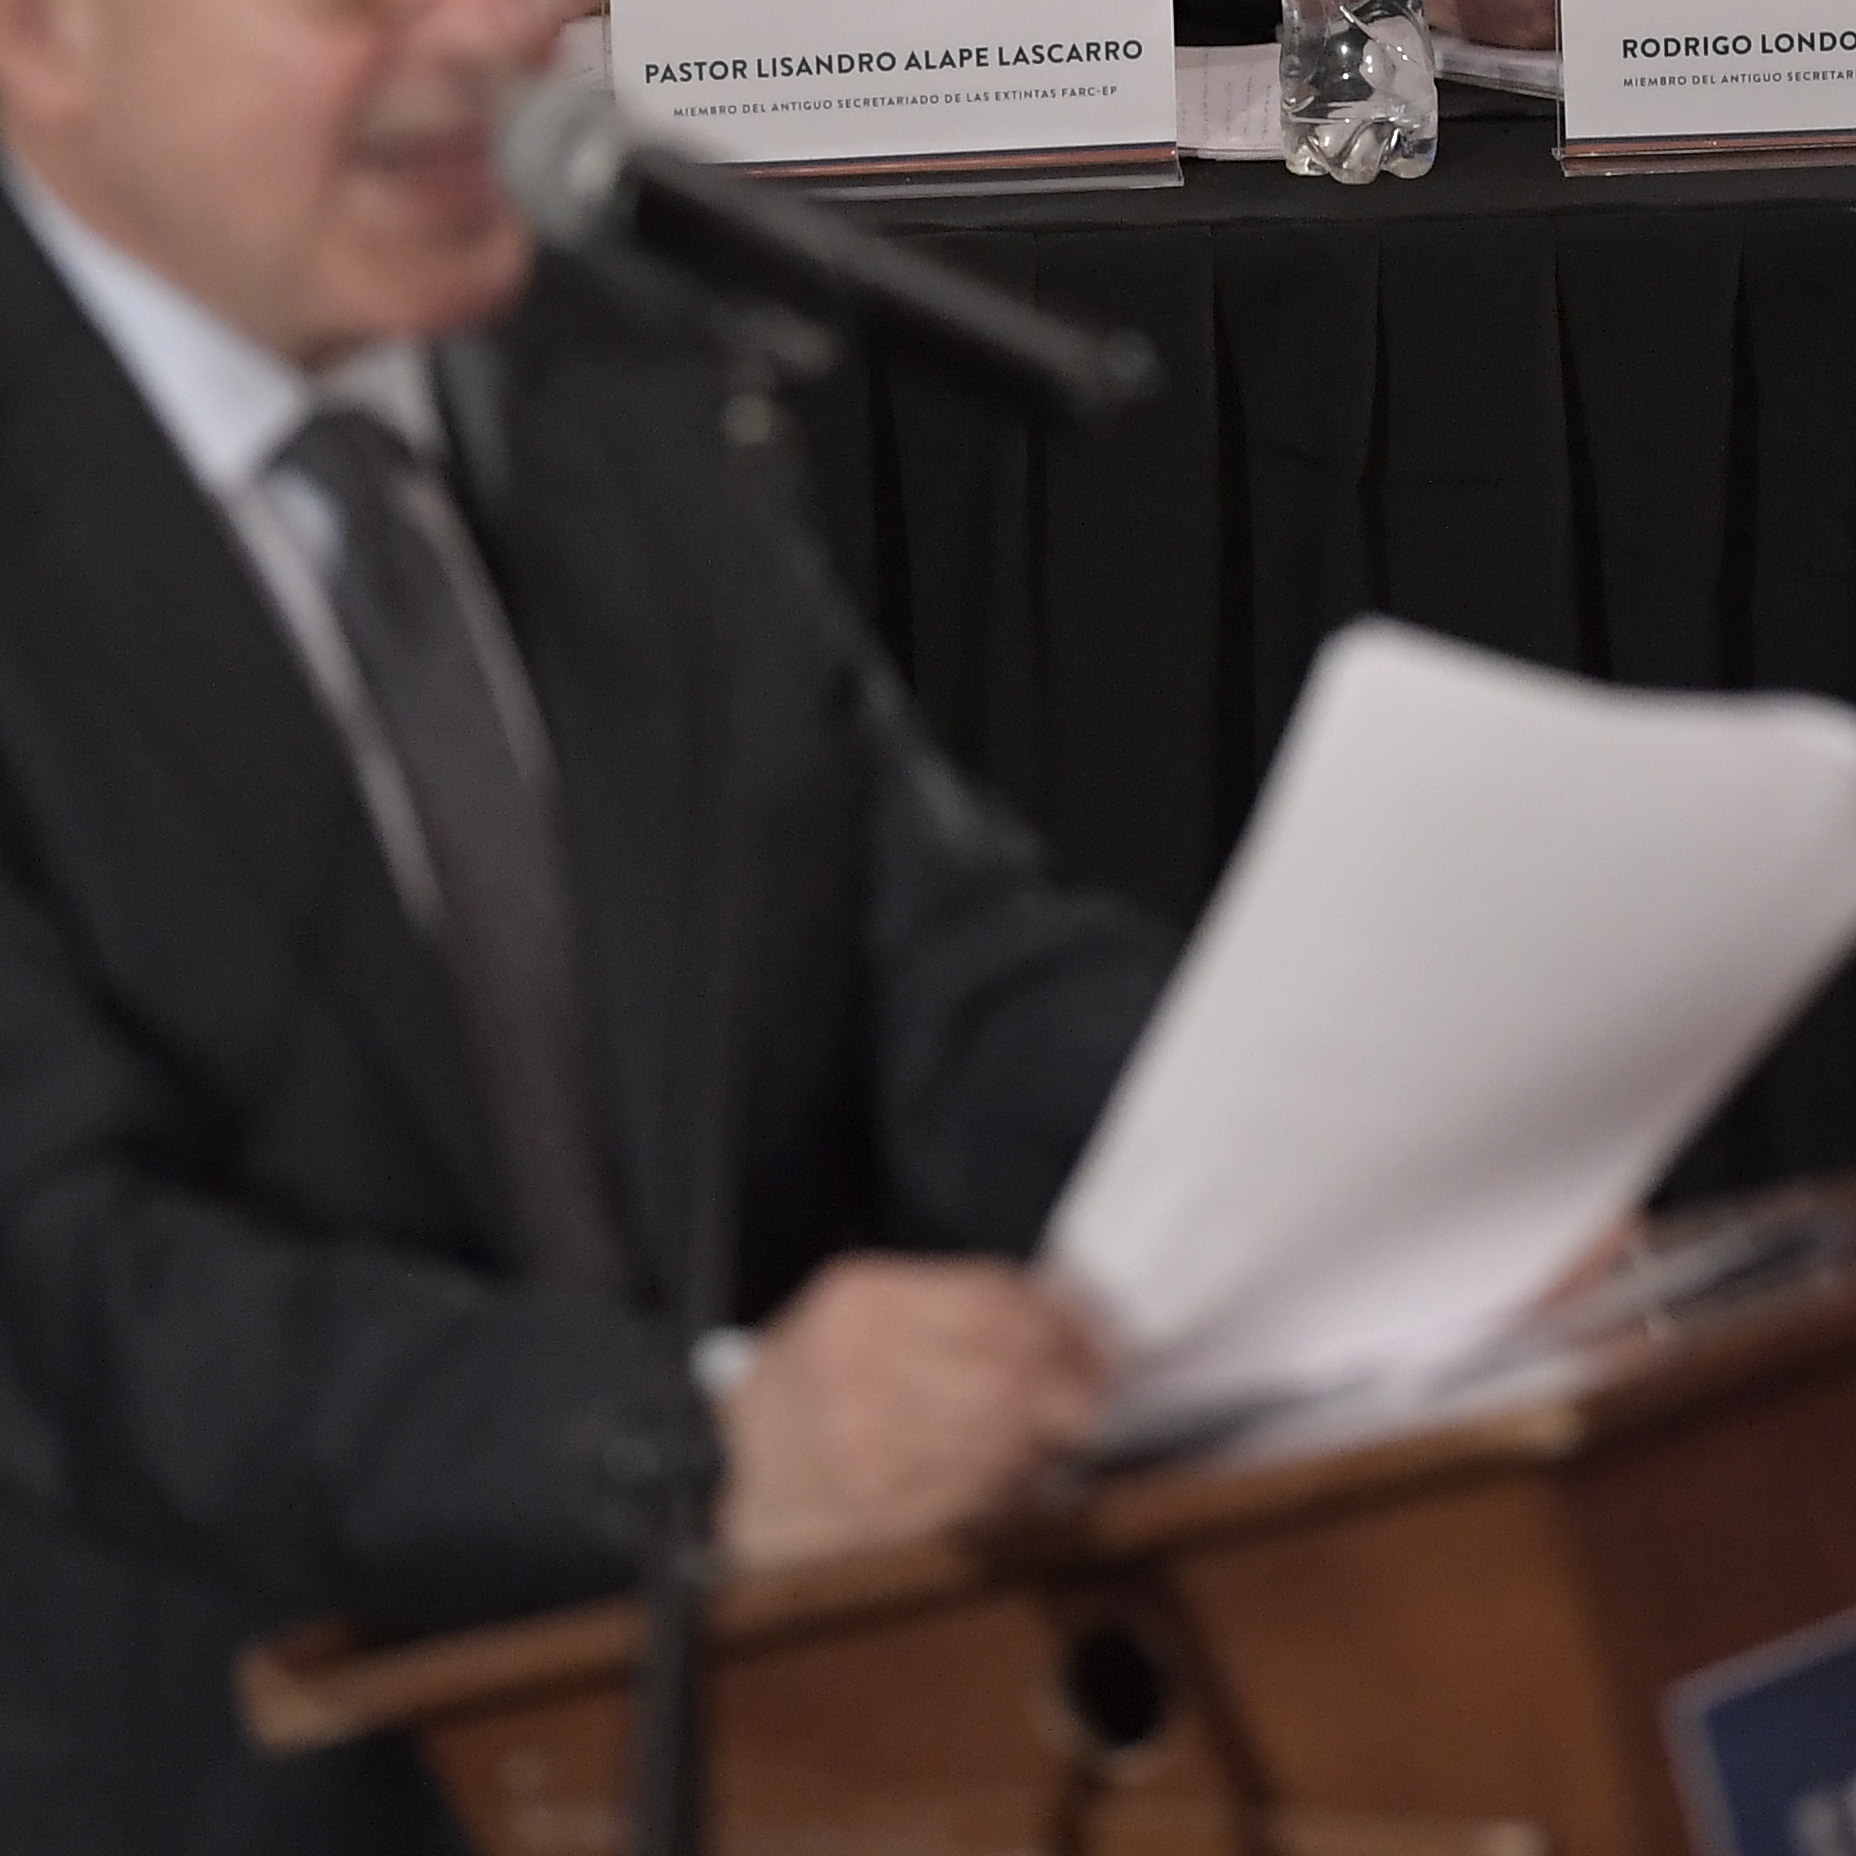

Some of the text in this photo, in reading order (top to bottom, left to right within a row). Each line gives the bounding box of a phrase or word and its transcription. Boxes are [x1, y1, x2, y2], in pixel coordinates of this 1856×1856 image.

[1621, 34, 1752, 59] RODRIGO
[644, 39, 1143, 84] PASTOR LISANDRO ALAPE LASCARRO
[1622, 74, 1687, 88] MIEMBRO
[1690, 73, 1716, 86] DEL
[1720, 71, 1782, 84] ANTIGUO
[672, 84, 1117, 117] MIEMBRO DEL ANTIGUO SECRETARIADO DE LAS EXTINTAS FARC-EP
